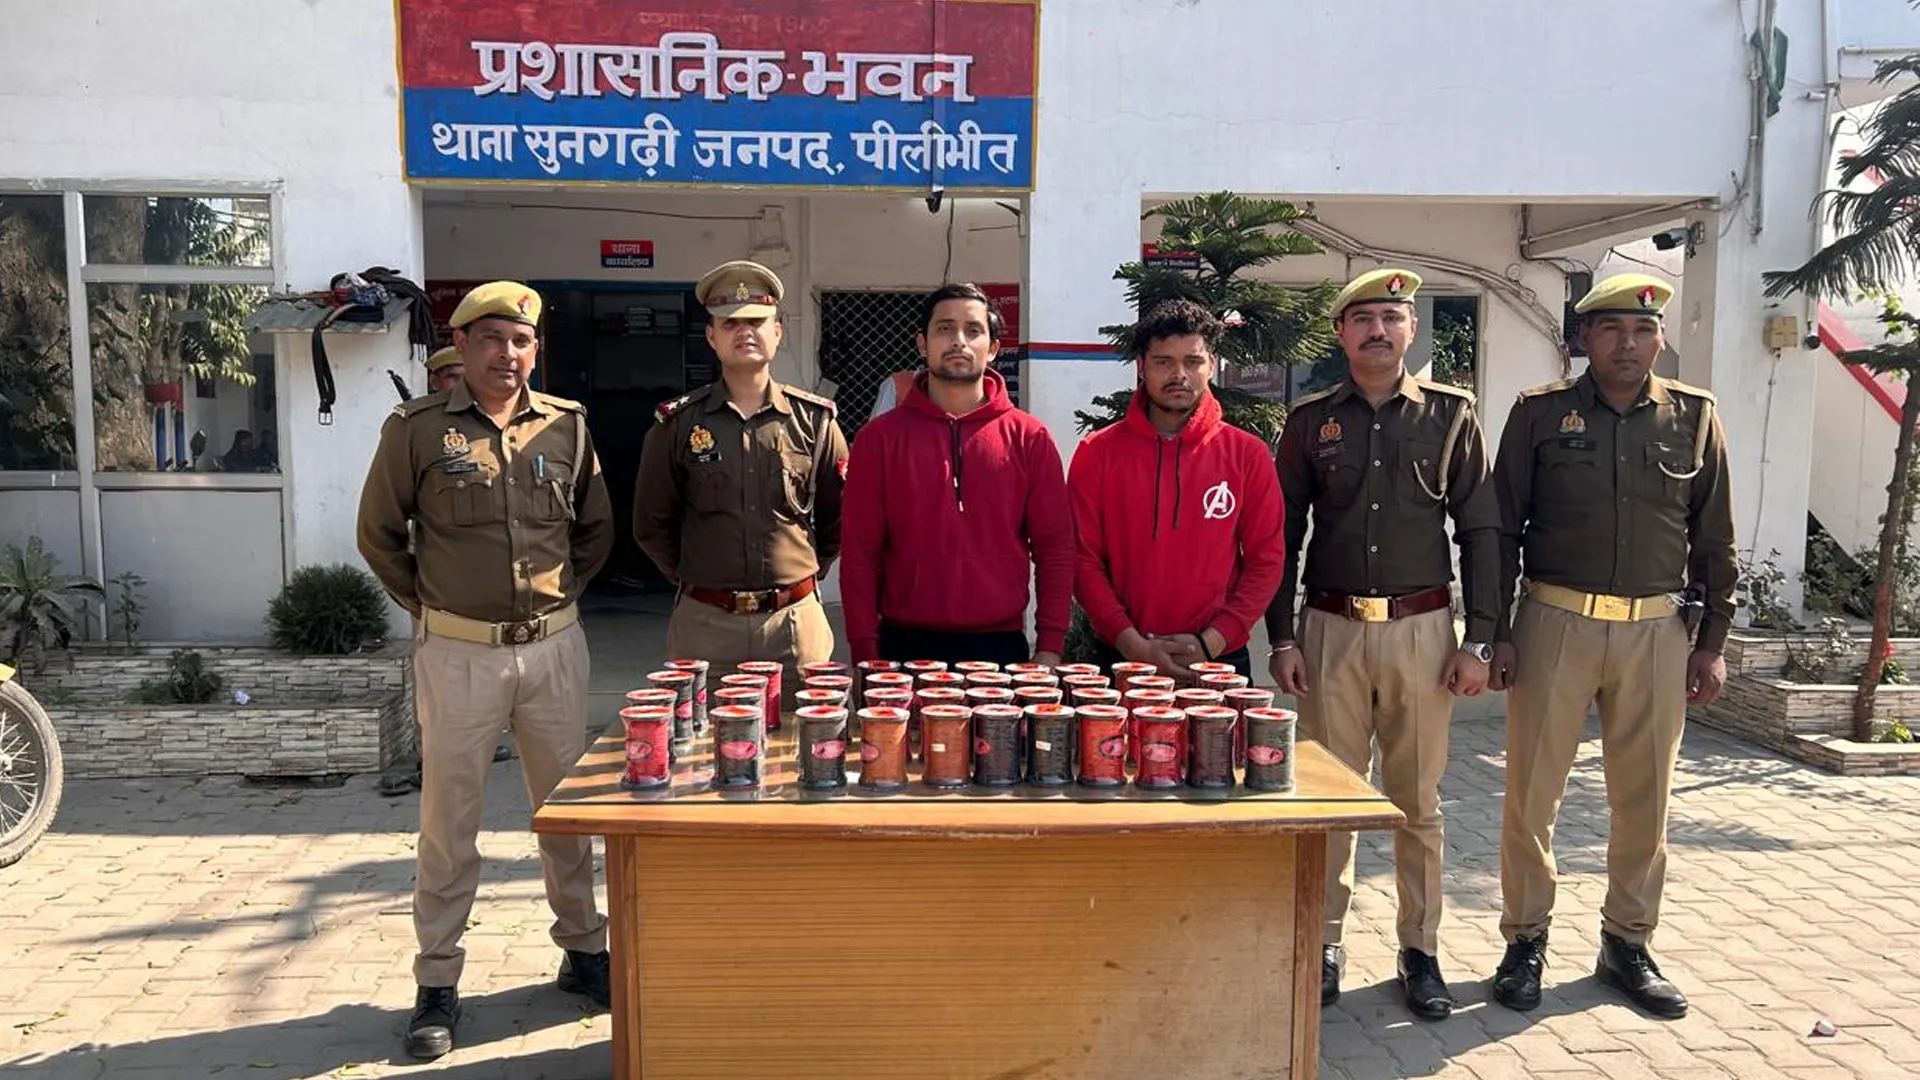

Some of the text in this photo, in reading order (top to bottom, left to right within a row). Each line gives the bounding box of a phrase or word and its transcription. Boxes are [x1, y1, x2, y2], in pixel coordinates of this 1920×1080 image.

[432, 122, 518, 162] थाना
[521, 112, 682, 177] सुनगढ़ी
[850, 119, 1018, 174] पीलीभीत
